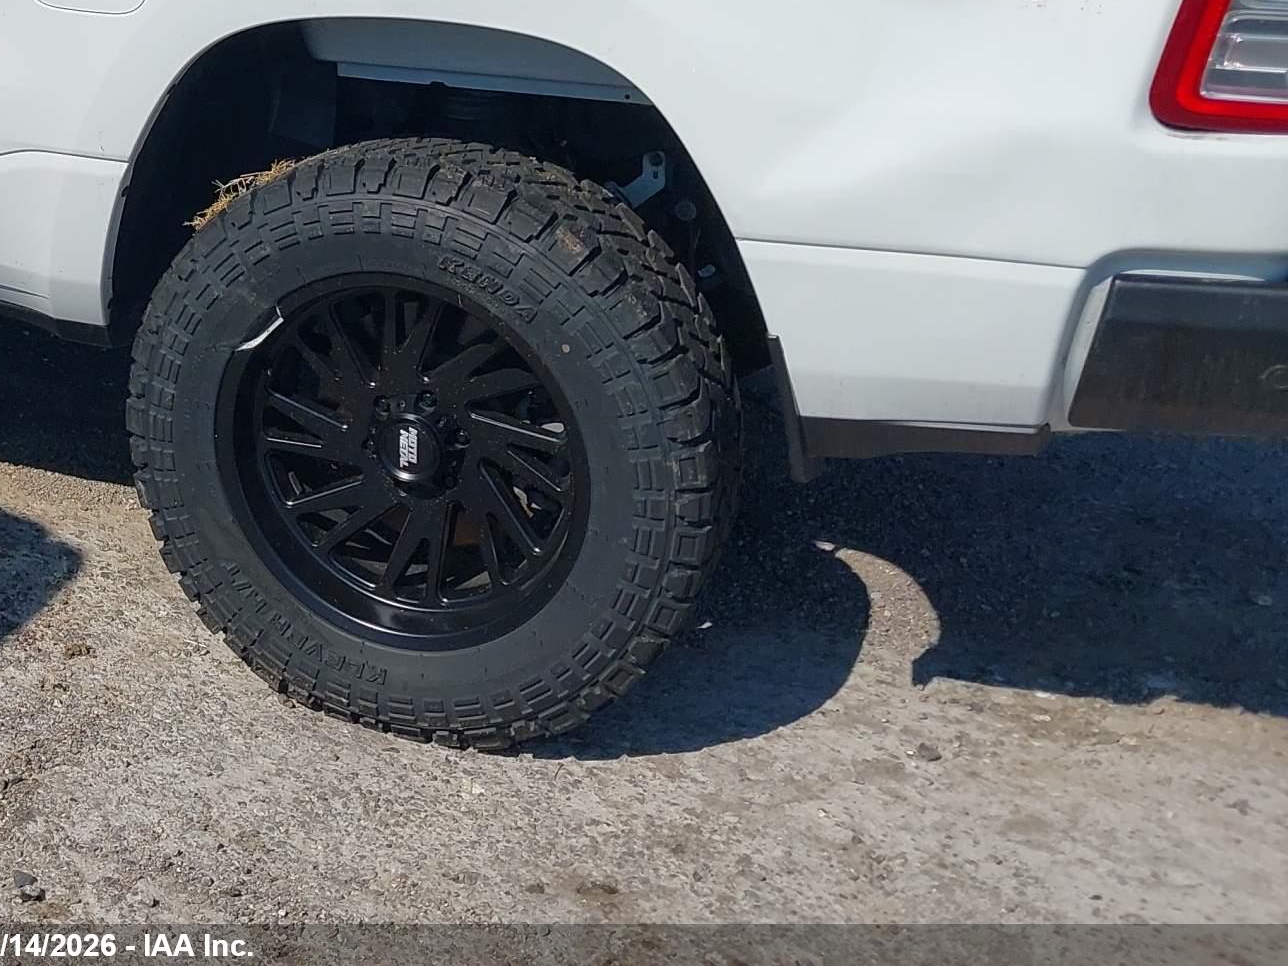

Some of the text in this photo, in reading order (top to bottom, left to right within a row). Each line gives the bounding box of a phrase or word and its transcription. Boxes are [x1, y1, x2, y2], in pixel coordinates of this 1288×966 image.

[438, 256, 538, 324] KENDA
[399, 428, 409, 469] METAL
[408, 426, 418, 465] MOTO
